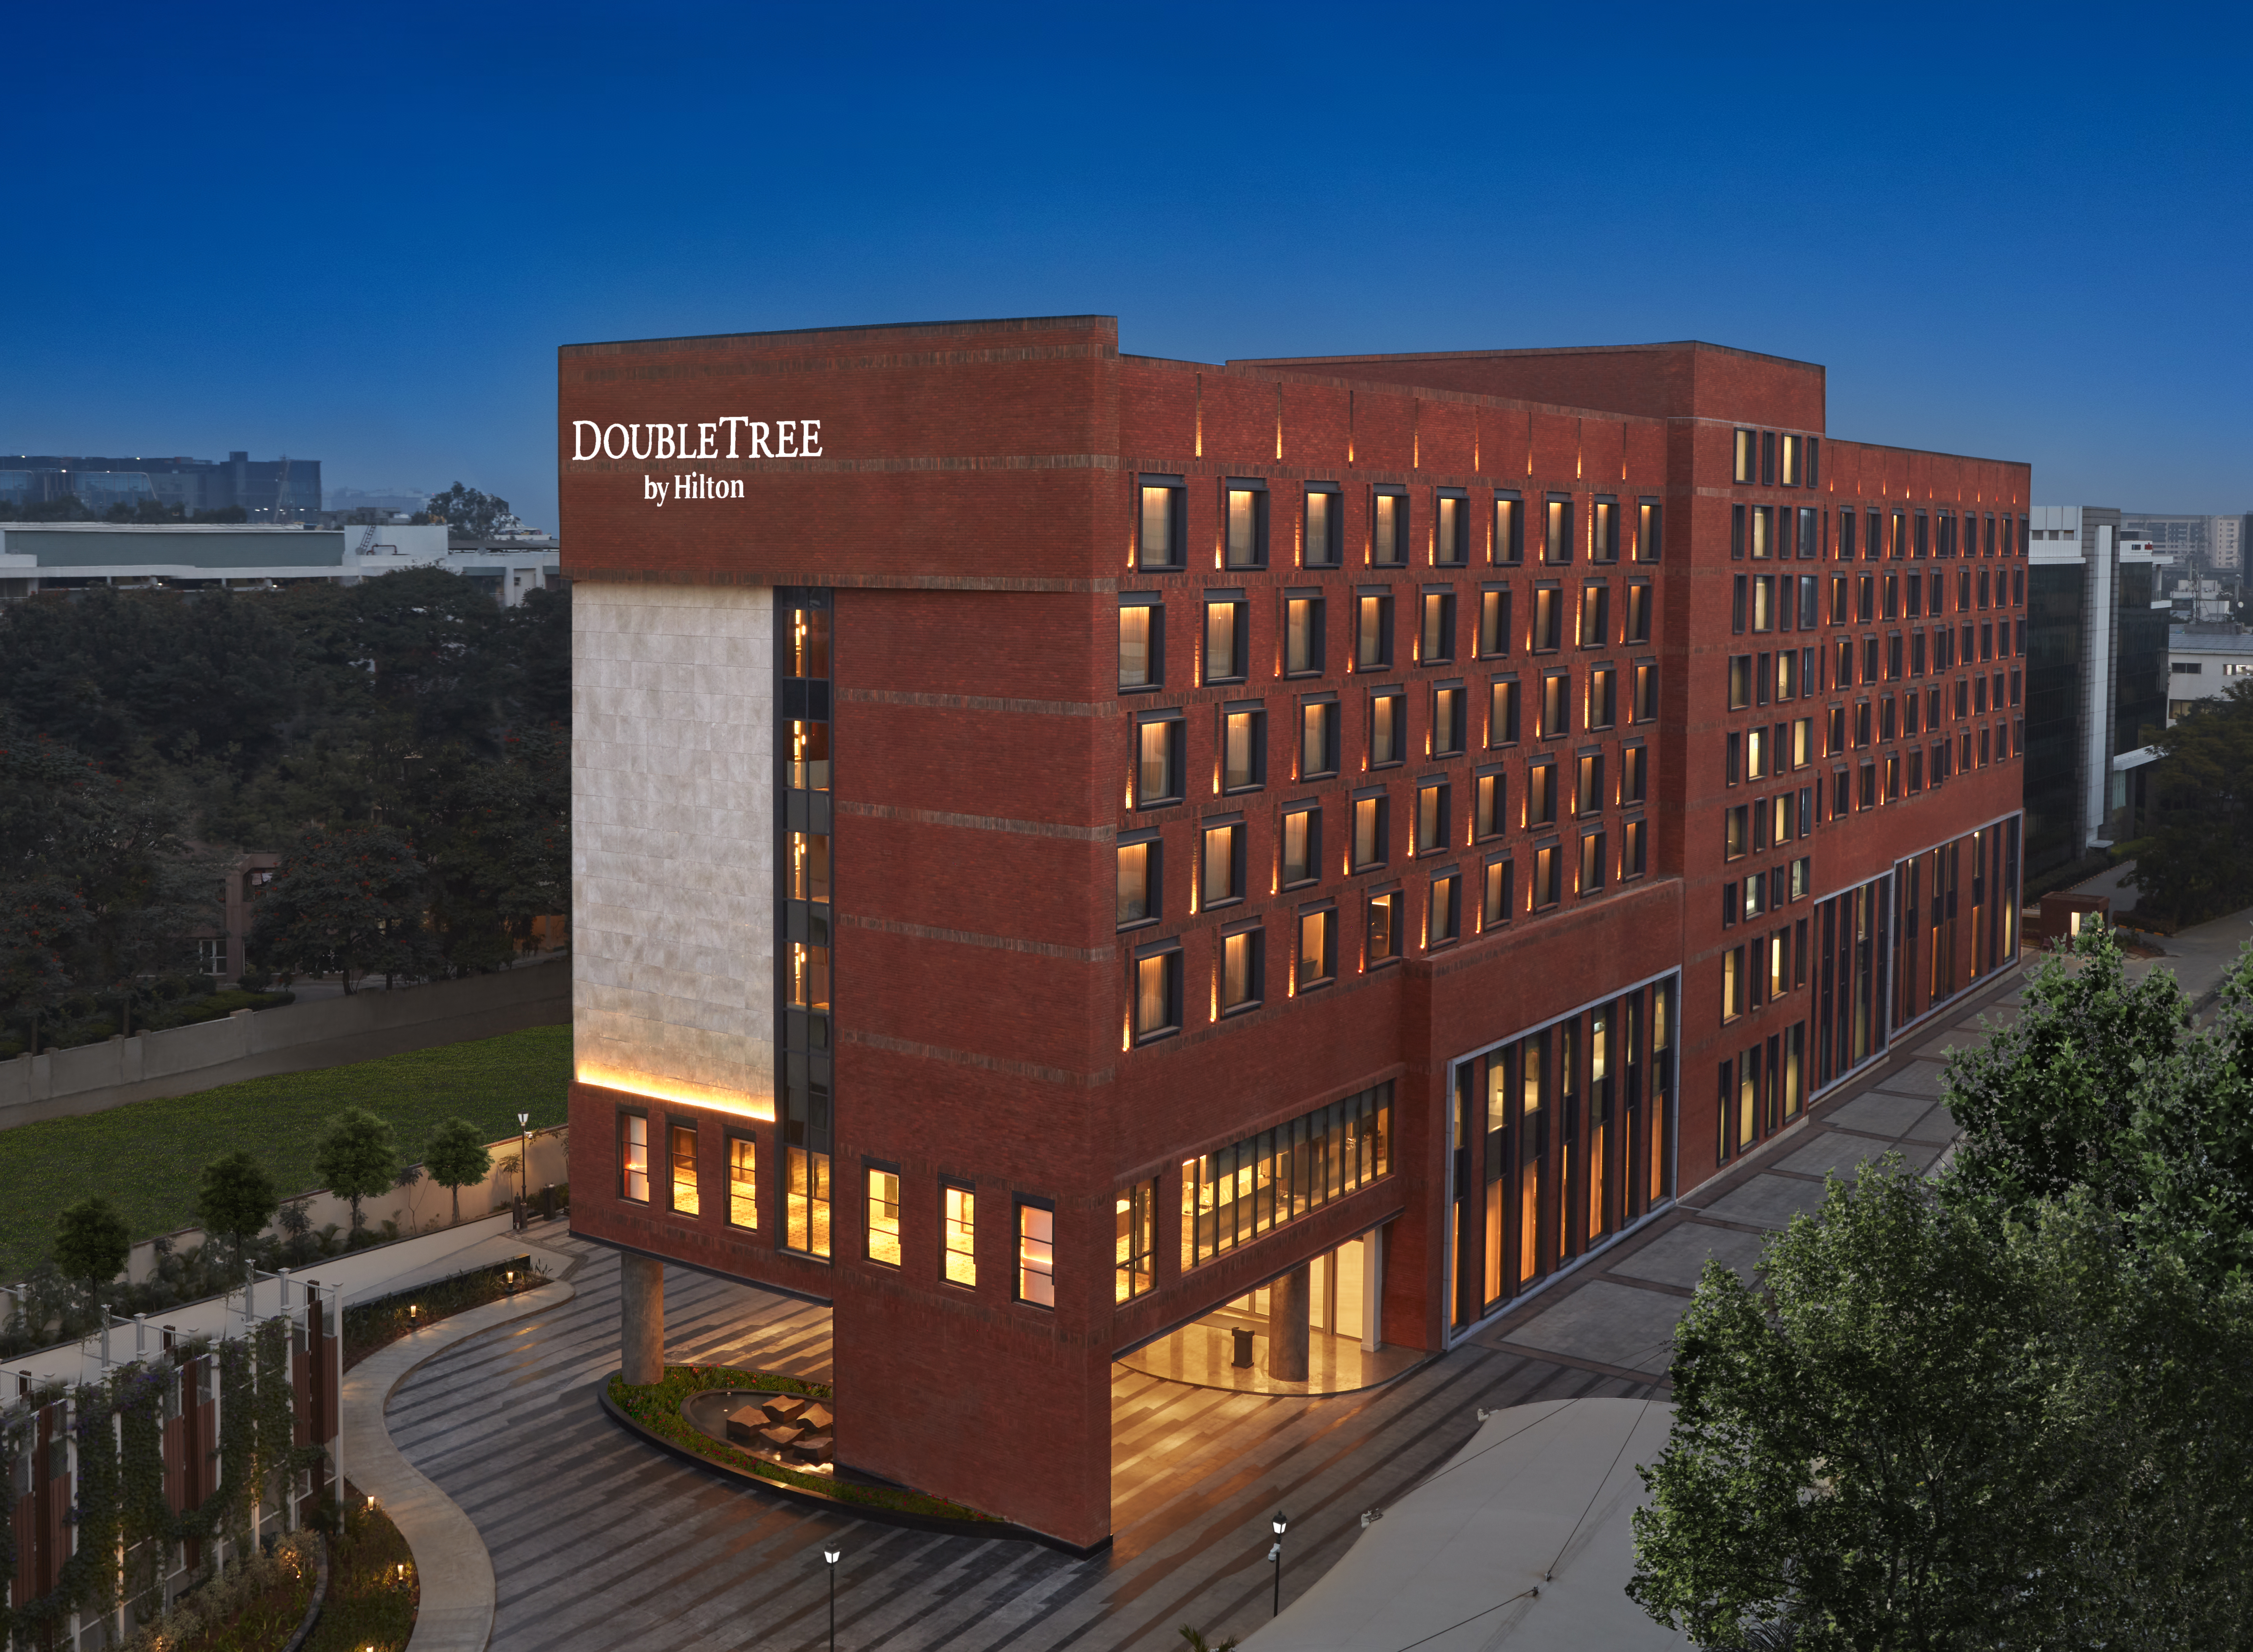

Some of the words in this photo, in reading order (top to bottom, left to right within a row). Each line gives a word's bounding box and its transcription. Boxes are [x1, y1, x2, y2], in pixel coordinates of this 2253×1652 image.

[572, 416, 823, 461] DOUBLETREE
[644, 475, 670, 507] by
[674, 471, 745, 499] Hilton
